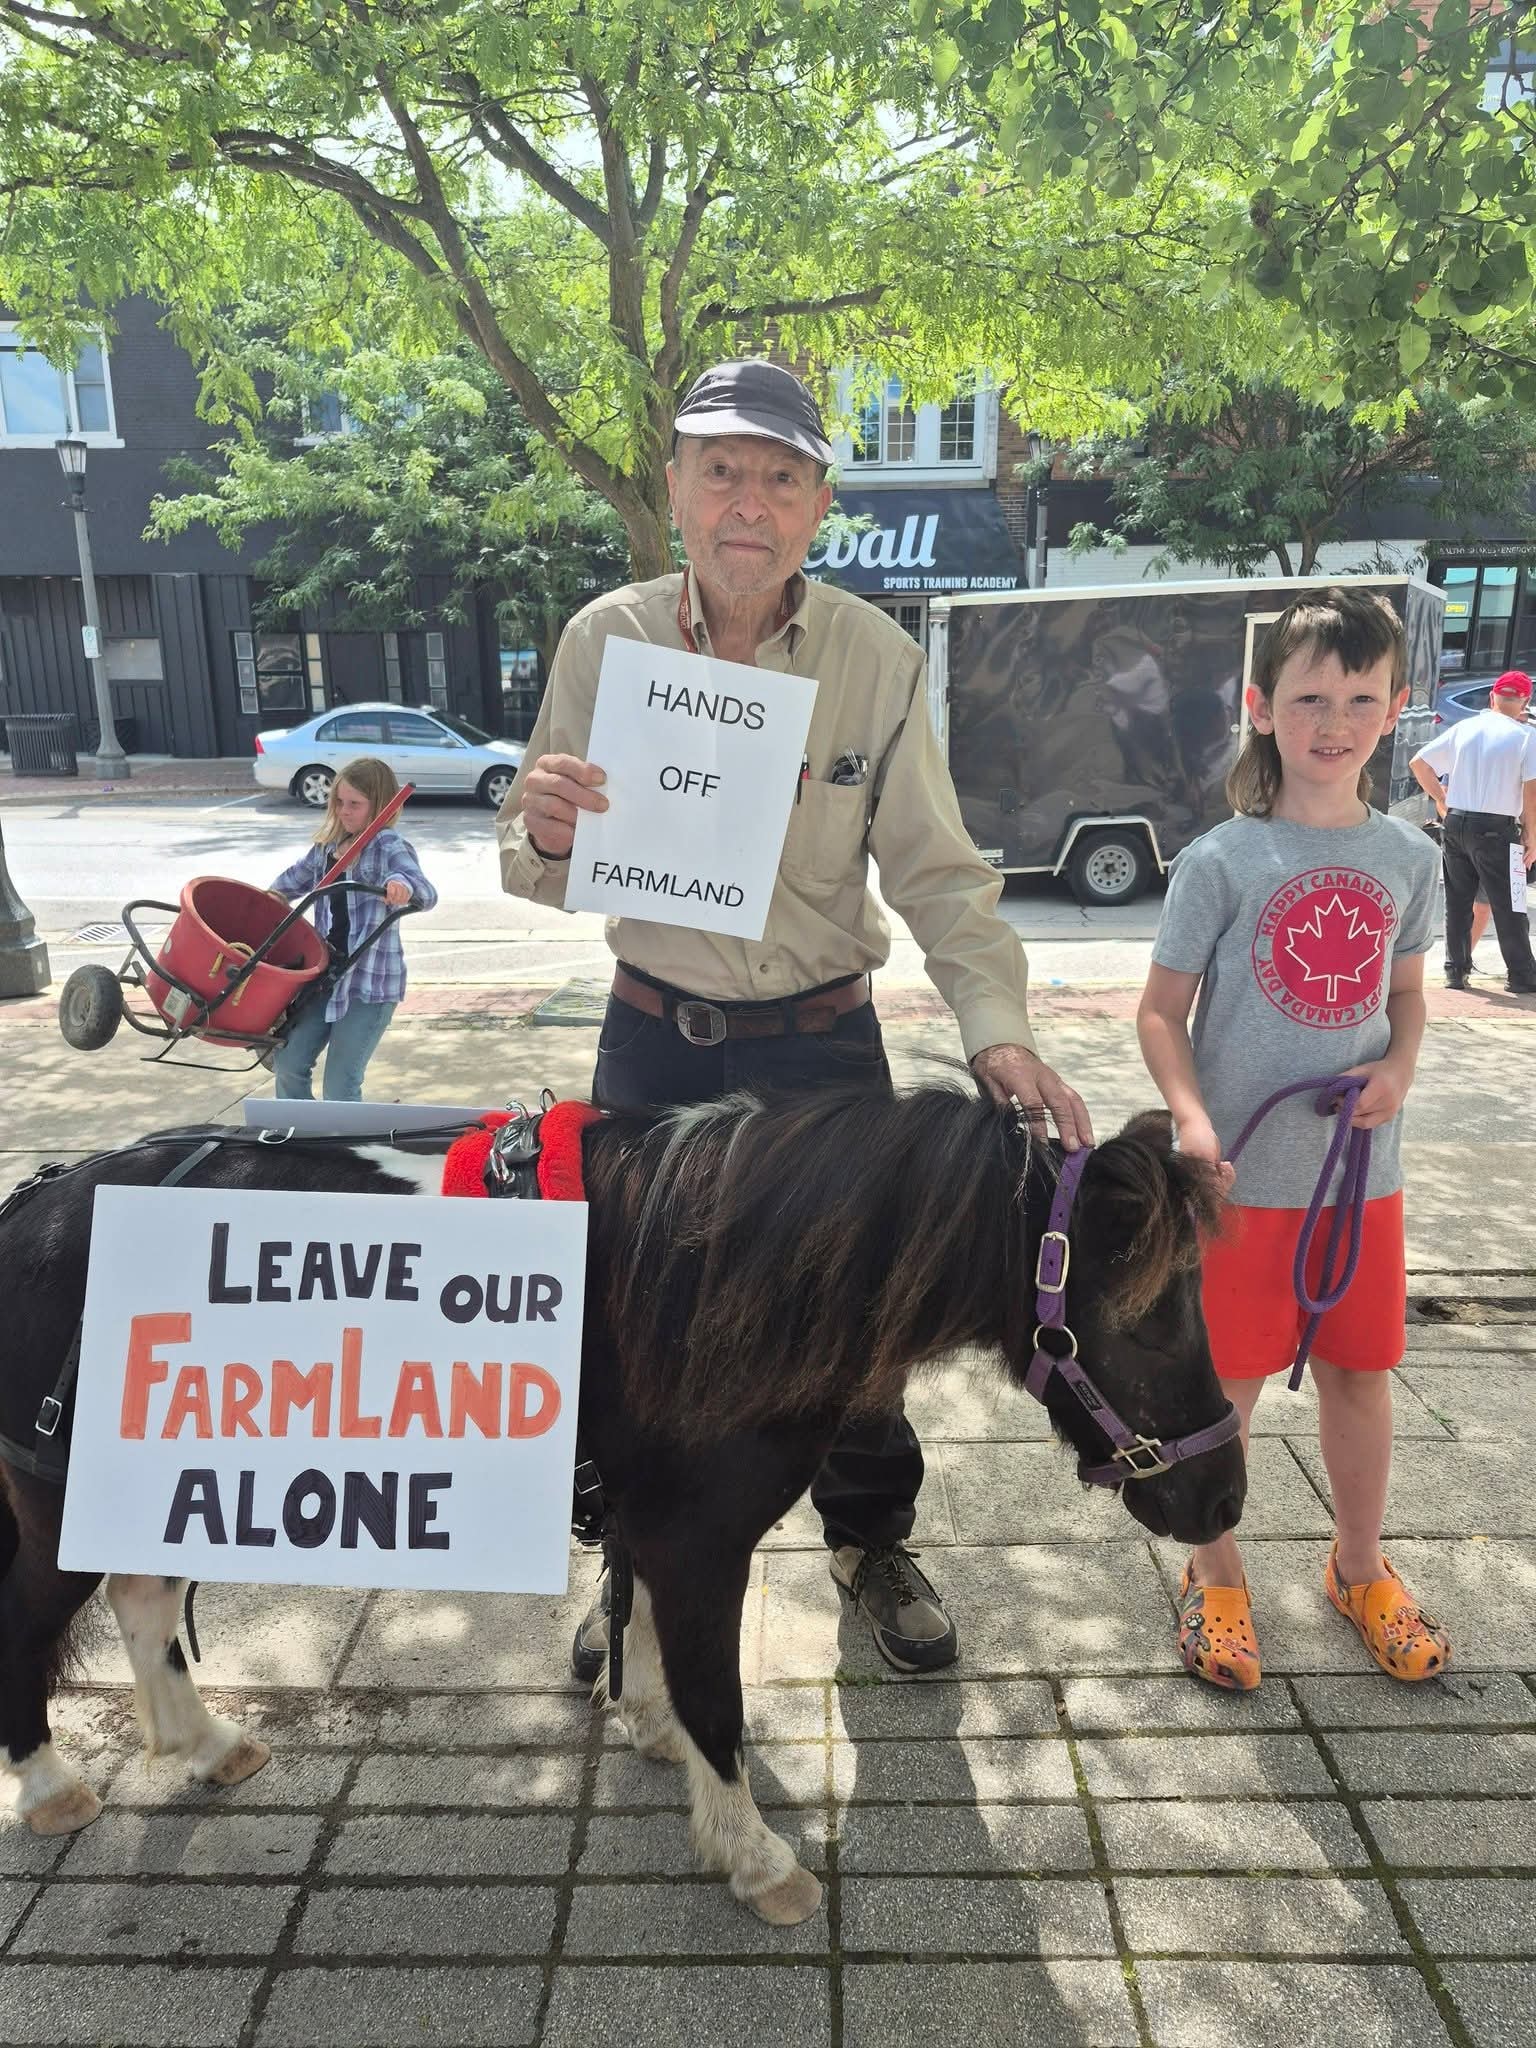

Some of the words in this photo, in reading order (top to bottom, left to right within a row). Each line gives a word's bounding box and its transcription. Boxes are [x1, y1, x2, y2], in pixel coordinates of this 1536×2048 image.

[802, 515, 938, 568] ball
[883, 577, 921, 589] SPORTS
[923, 577, 968, 589] TRAINING
[970, 577, 1018, 589] ACADEMY
[647, 680, 766, 730] HANDS
[659, 765, 721, 799] OFF
[592, 861, 744, 909] FARMLAND
[1262, 881, 1307, 937] HAPPY
[1311, 873, 1385, 906] CANADA
[1382, 904, 1396, 937] DAY
[1258, 959, 1283, 992] DAY
[1280, 993, 1356, 1024] CANADA
[208, 1222, 422, 1304] LEAVE
[440, 1273, 563, 1324] OUR
[120, 1312, 562, 1441] FARMLAND
[162, 1468, 453, 1550] ALONE
